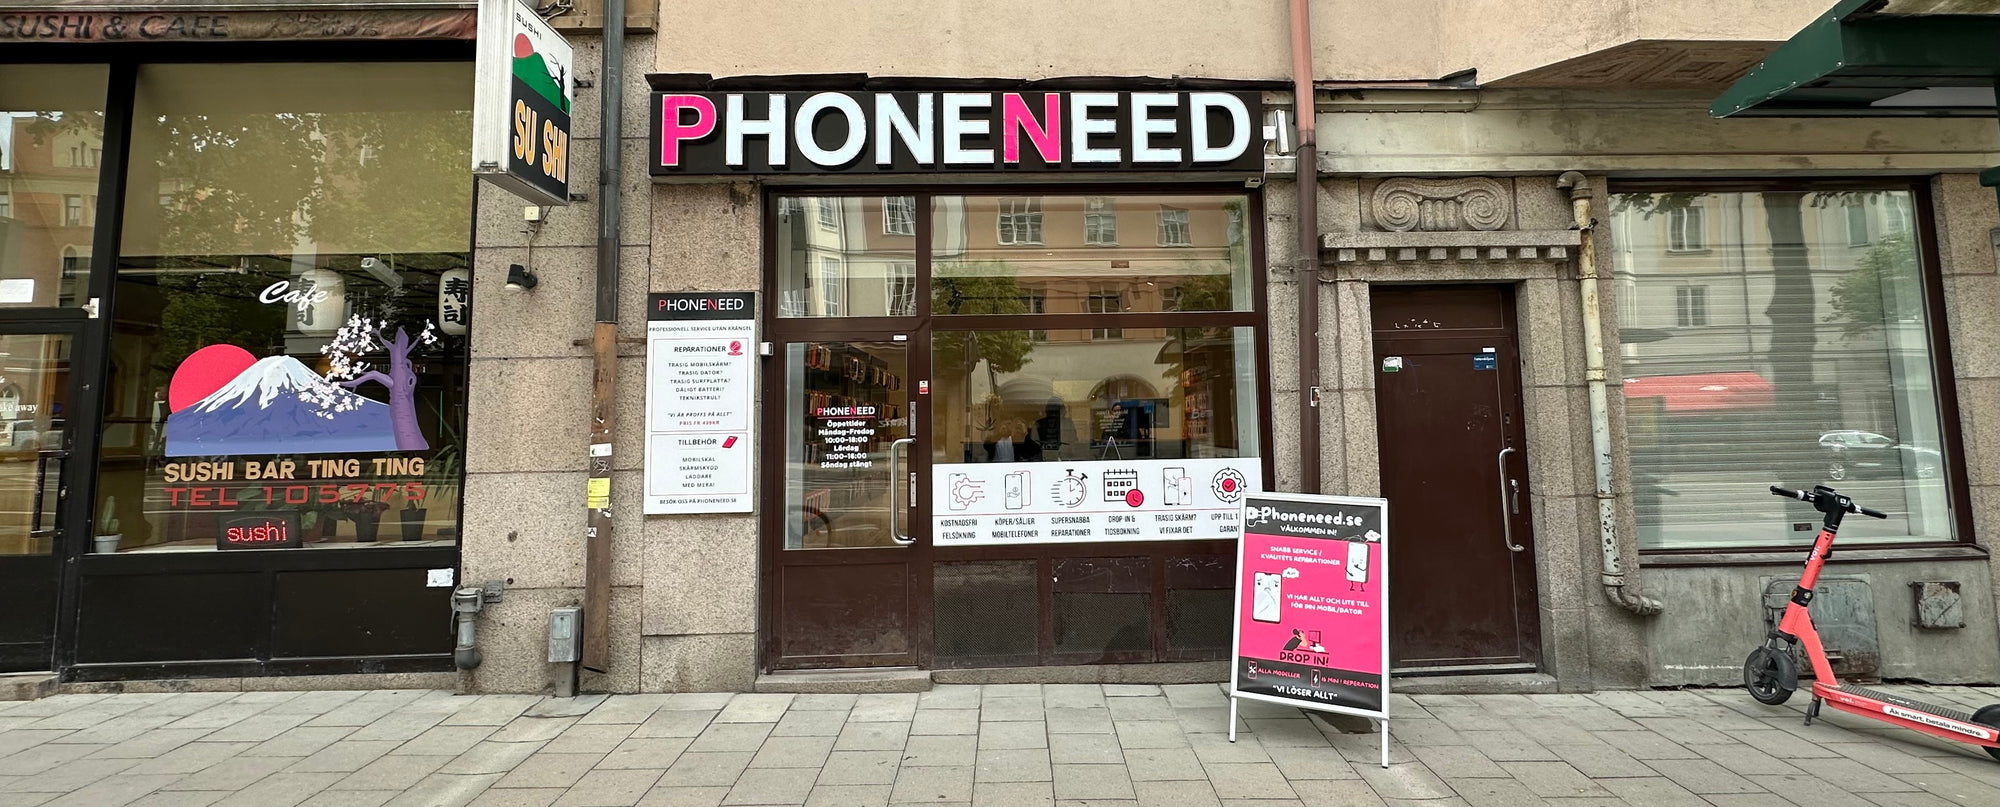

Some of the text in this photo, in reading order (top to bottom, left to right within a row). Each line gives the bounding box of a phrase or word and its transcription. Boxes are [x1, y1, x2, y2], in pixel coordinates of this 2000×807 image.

[0, 15, 229, 39] SUSHI & CAFE
[515, 12, 542, 41] SUSHI
[661, 91, 1251, 167] PHONENEED
[259, 280, 329, 312] Cafe
[658, 298, 745, 311] PHONENEED
[15, 404, 39, 413] away
[817, 406, 876, 416] PHONENEED
[826, 420, 866, 428] Öppettider
[678, 437, 717, 446] TILLBEHÖR
[164, 457, 425, 483] SUSHI BAR TING TING
[164, 482, 426, 506] TEL 105775
[1050, 516, 1090, 525] SUPERSNABBA
[1155, 514, 1174, 523] TRASIG
[1210, 513, 1222, 521] UPP
[1261, 506, 1364, 527] Phoneneed.se
[940, 519, 978, 527] KOSTNADSFRI
[226, 520, 288, 542] sushi
[942, 531, 976, 540] FELSÖKNING
[991, 529, 1039, 538] MOBILTELEFONER
[1050, 528, 1091, 537] REPARATIONER
[1165, 526, 1182, 534] FIXAR
[1183, 525, 1193, 533] DET
[1270, 545, 1292, 554] SNABB
[1292, 547, 1318, 556] SERVICE
[1260, 553, 1293, 562] KVALITETS
[1309, 595, 1325, 603] ALLT
[1325, 597, 1341, 605] OCH
[1356, 600, 1370, 608] TILL
[1290, 601, 1304, 609] FÖR
[1316, 604, 1363, 616] MOBIL/DATOR
[1279, 651, 1330, 667] DROP IN!
[1257, 667, 1301, 679] ALLA MODELLER
[1286, 685, 1312, 698] LÖSER
[1900, 711, 1925, 723] smart,
[1925, 717, 1951, 728] betala
[1951, 723, 1984, 738] mindre.
